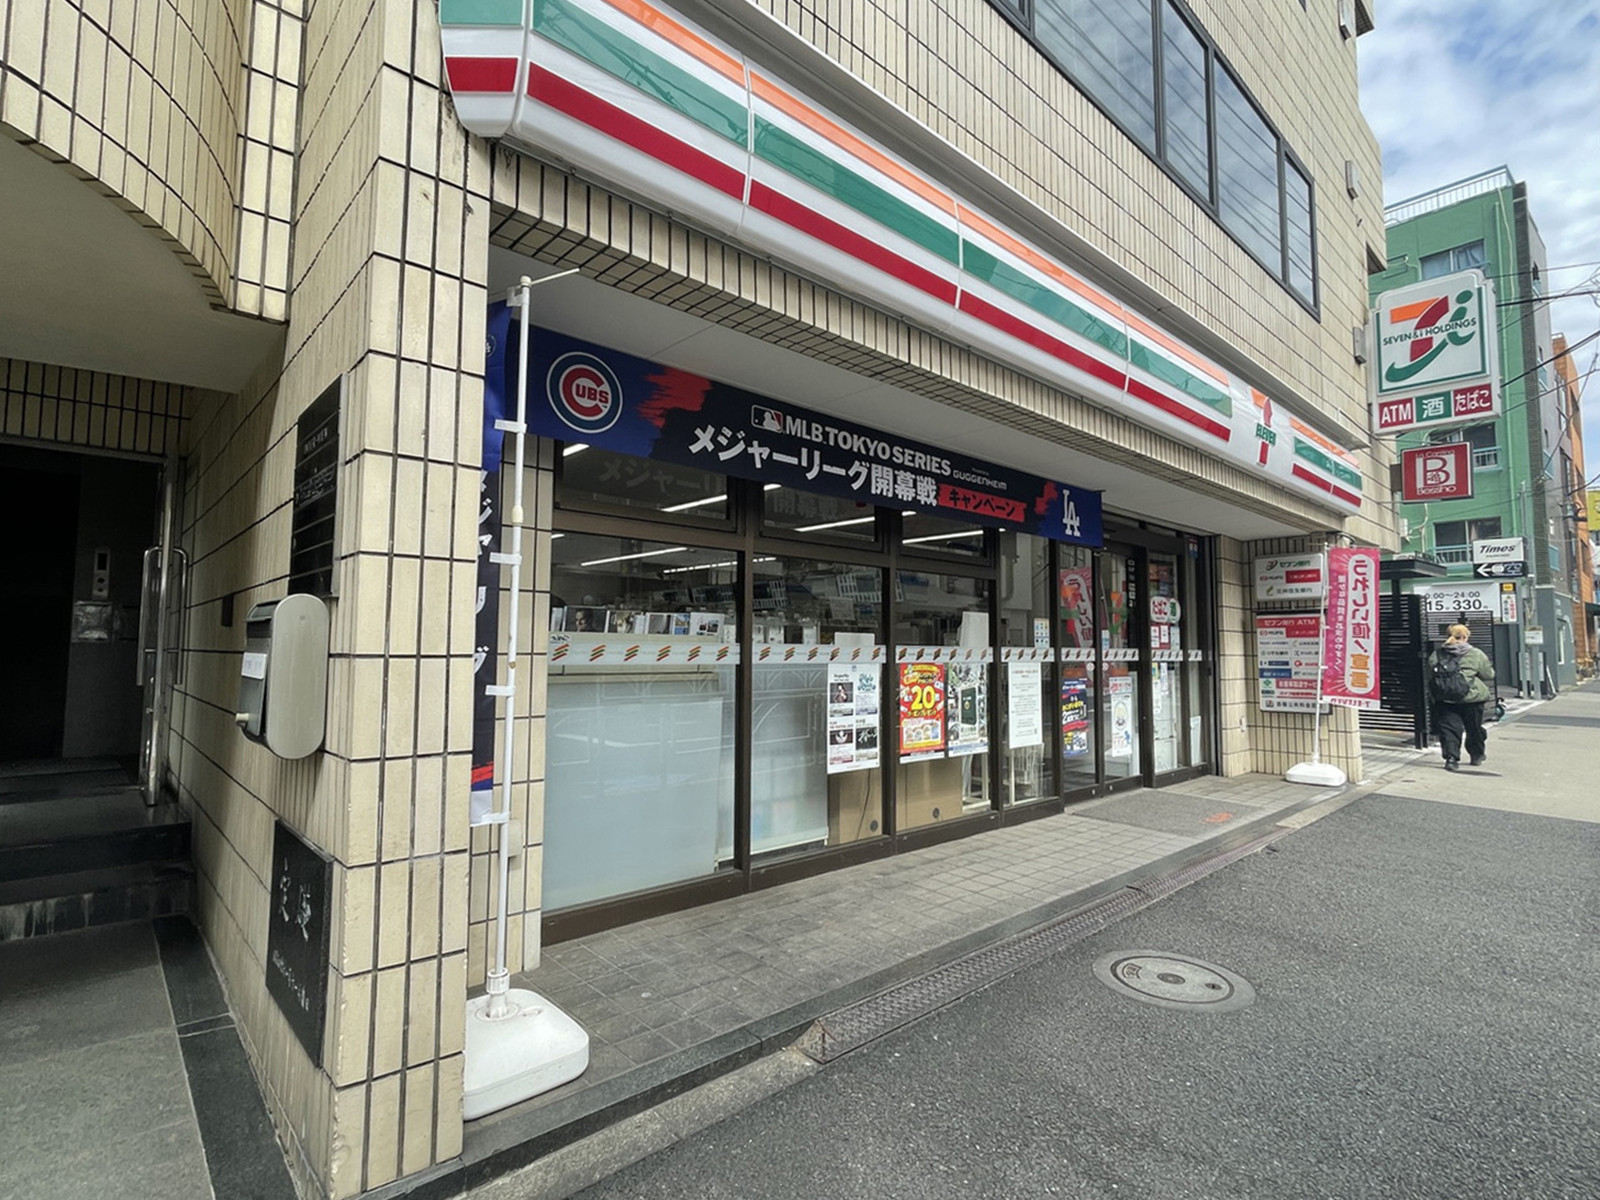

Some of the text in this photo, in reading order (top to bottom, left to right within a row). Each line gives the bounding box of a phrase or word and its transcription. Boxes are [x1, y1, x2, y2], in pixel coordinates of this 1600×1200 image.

[1425, 317, 1477, 336] HOLDINGS
[1421, 396, 1445, 419] 酒
[1455, 390, 1491, 412] たばこ
[1381, 402, 1411, 424] ATM
[785, 415, 952, 477] MLB TOKYO SERIES
[688, 423, 939, 508] メジャーリーグ開幕戦
[949, 488, 1017, 517] キャンペーン
[1480, 544, 1516, 554] Times
[1297, 618, 1316, 626] ATM
[910, 685, 936, 711] 20
